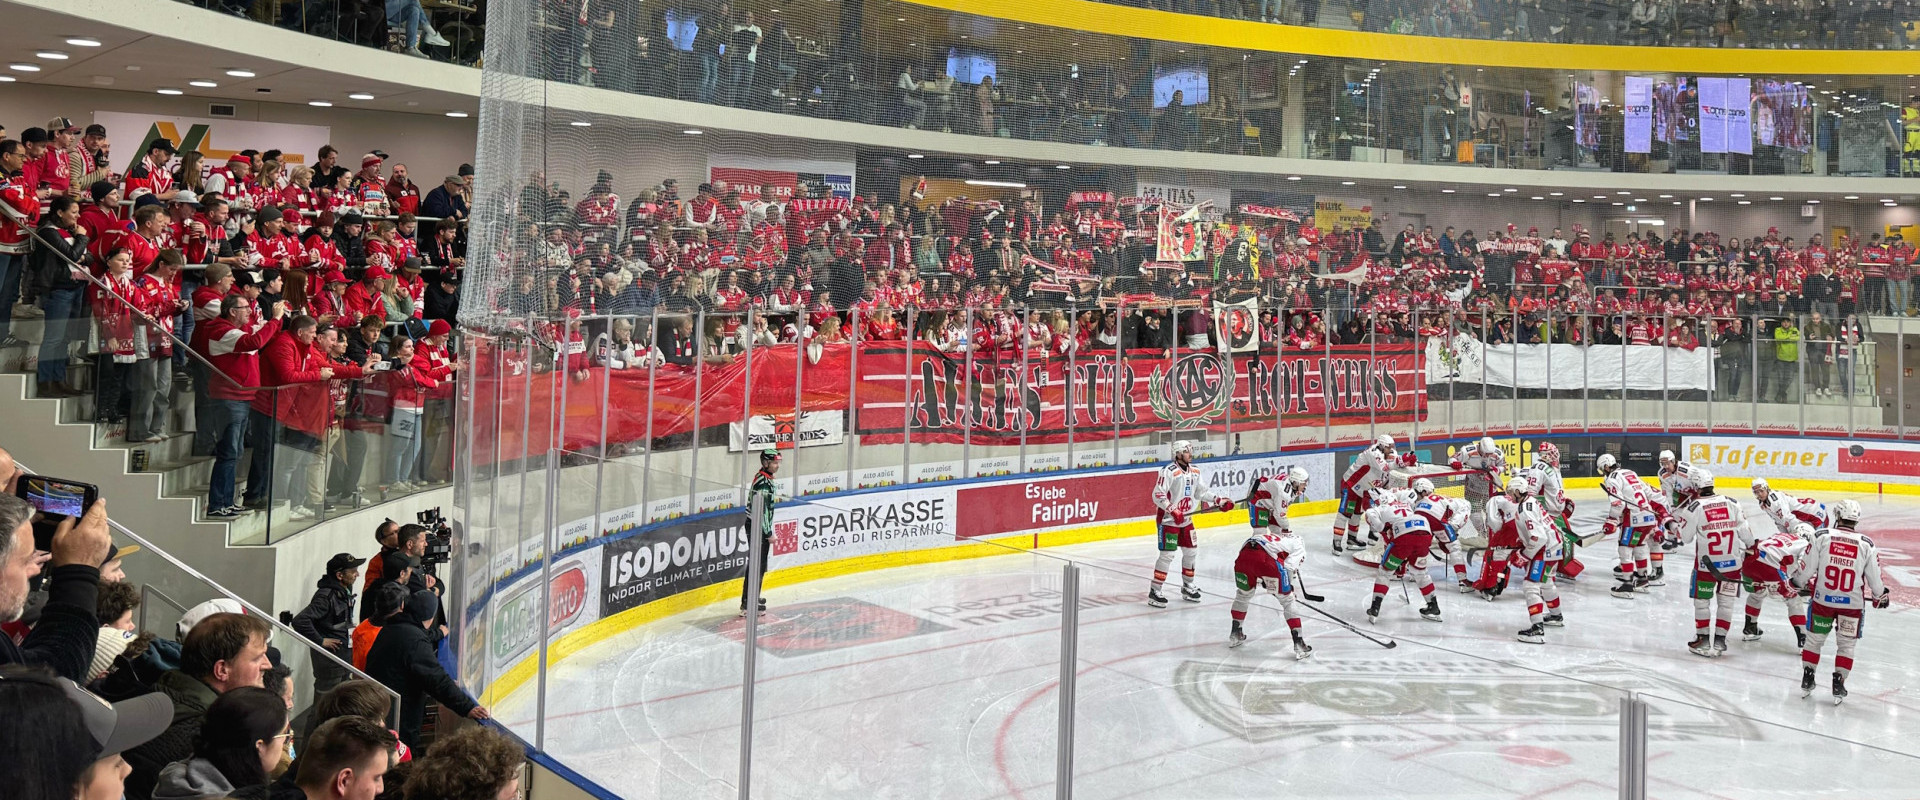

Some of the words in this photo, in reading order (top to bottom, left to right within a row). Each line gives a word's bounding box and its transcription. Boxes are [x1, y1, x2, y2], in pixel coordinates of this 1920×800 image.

[734, 184, 792, 196] MARER
[1063, 355, 1136, 426] FÜR
[1715, 444, 1828, 470] Taferner
[1026, 484, 1040, 499] Es
[1042, 486, 1066, 500] lebe
[802, 499, 944, 538] SPARKASSE
[1032, 498, 1098, 524] Fairplay
[802, 536, 846, 551] CASSA
[852, 533, 864, 543] DI
[872, 522, 944, 540] RISPARMIO
[1707, 530, 1734, 556] 27
[608, 526, 750, 588] ISODOMUS
[1830, 556, 1854, 568] FRASER
[608, 582, 651, 603] INDOOR
[656, 567, 702, 587] CLIMATE
[1824, 566, 1856, 593] 90
[552, 585, 577, 623] UNO
